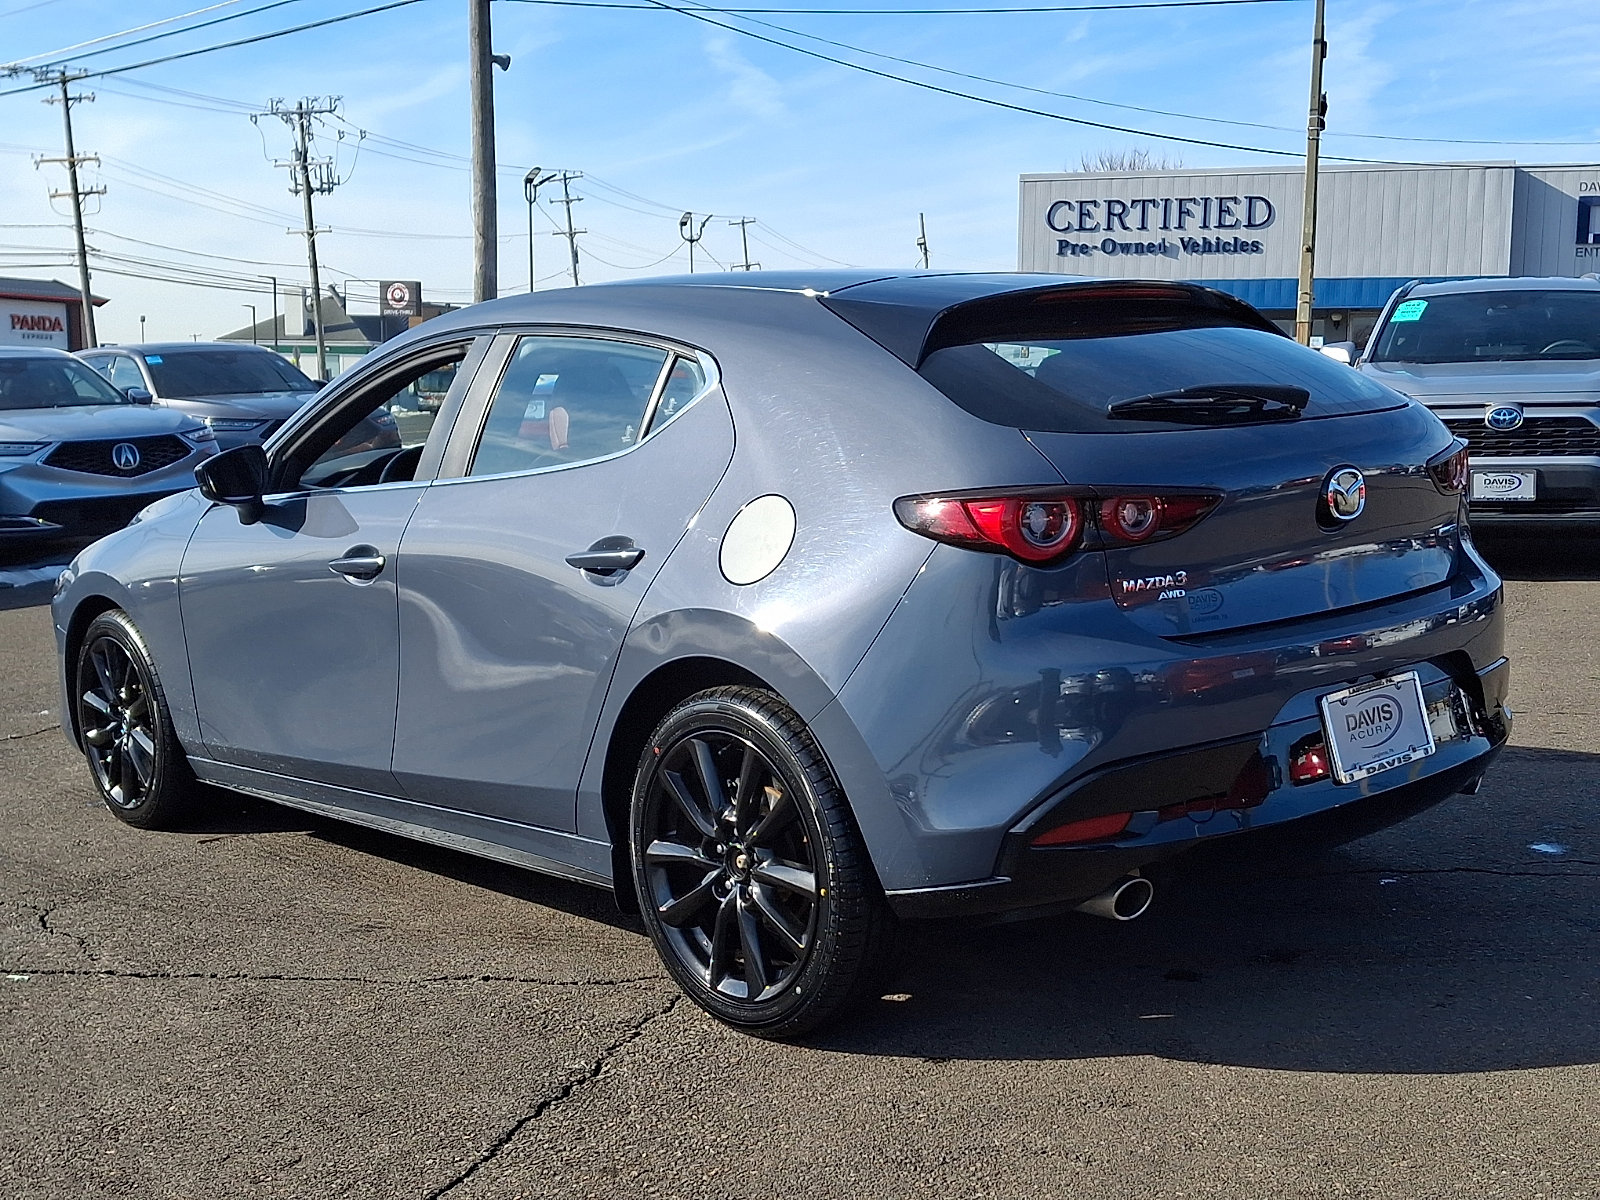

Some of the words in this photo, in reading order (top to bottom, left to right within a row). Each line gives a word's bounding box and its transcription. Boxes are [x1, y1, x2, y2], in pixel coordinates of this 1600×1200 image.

[1046, 195, 1276, 233] CERTIFIED
[1056, 238, 1170, 257] Pre-Owned
[1179, 236, 1264, 255] Vehicles
[10, 313, 64, 331] PANDA
[1158, 589, 1186, 601] AWD
[1187, 592, 1218, 605] DAVIS
[1345, 703, 1393, 732] DAVIS
[1349, 723, 1392, 742] ACURA
[1366, 754, 1413, 774] DAVIS
